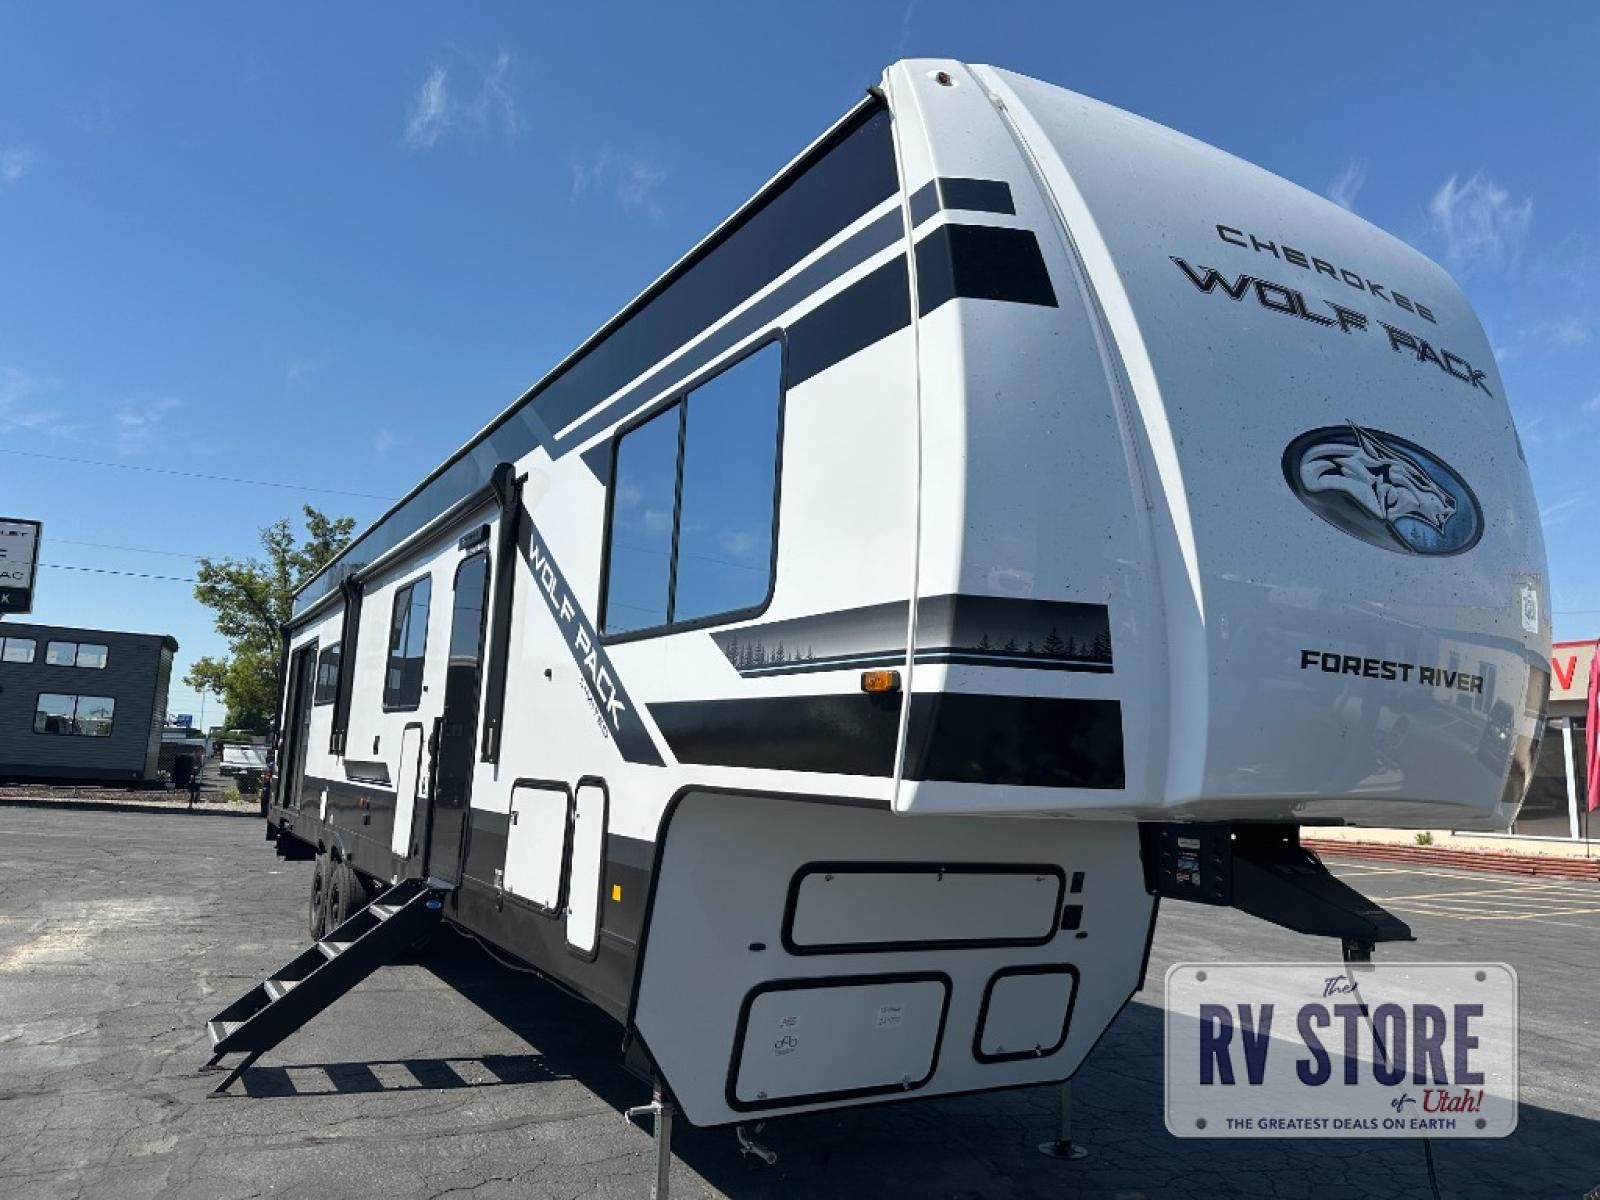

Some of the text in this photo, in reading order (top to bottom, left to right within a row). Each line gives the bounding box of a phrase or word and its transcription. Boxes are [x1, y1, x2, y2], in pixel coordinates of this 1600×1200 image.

[1168, 256, 1495, 397] WOLF PACK
[1216, 224, 1437, 324] CHEROKEE
[529, 534, 626, 730] WOLF PACK
[1300, 649, 1484, 695] FOREST RIVER
